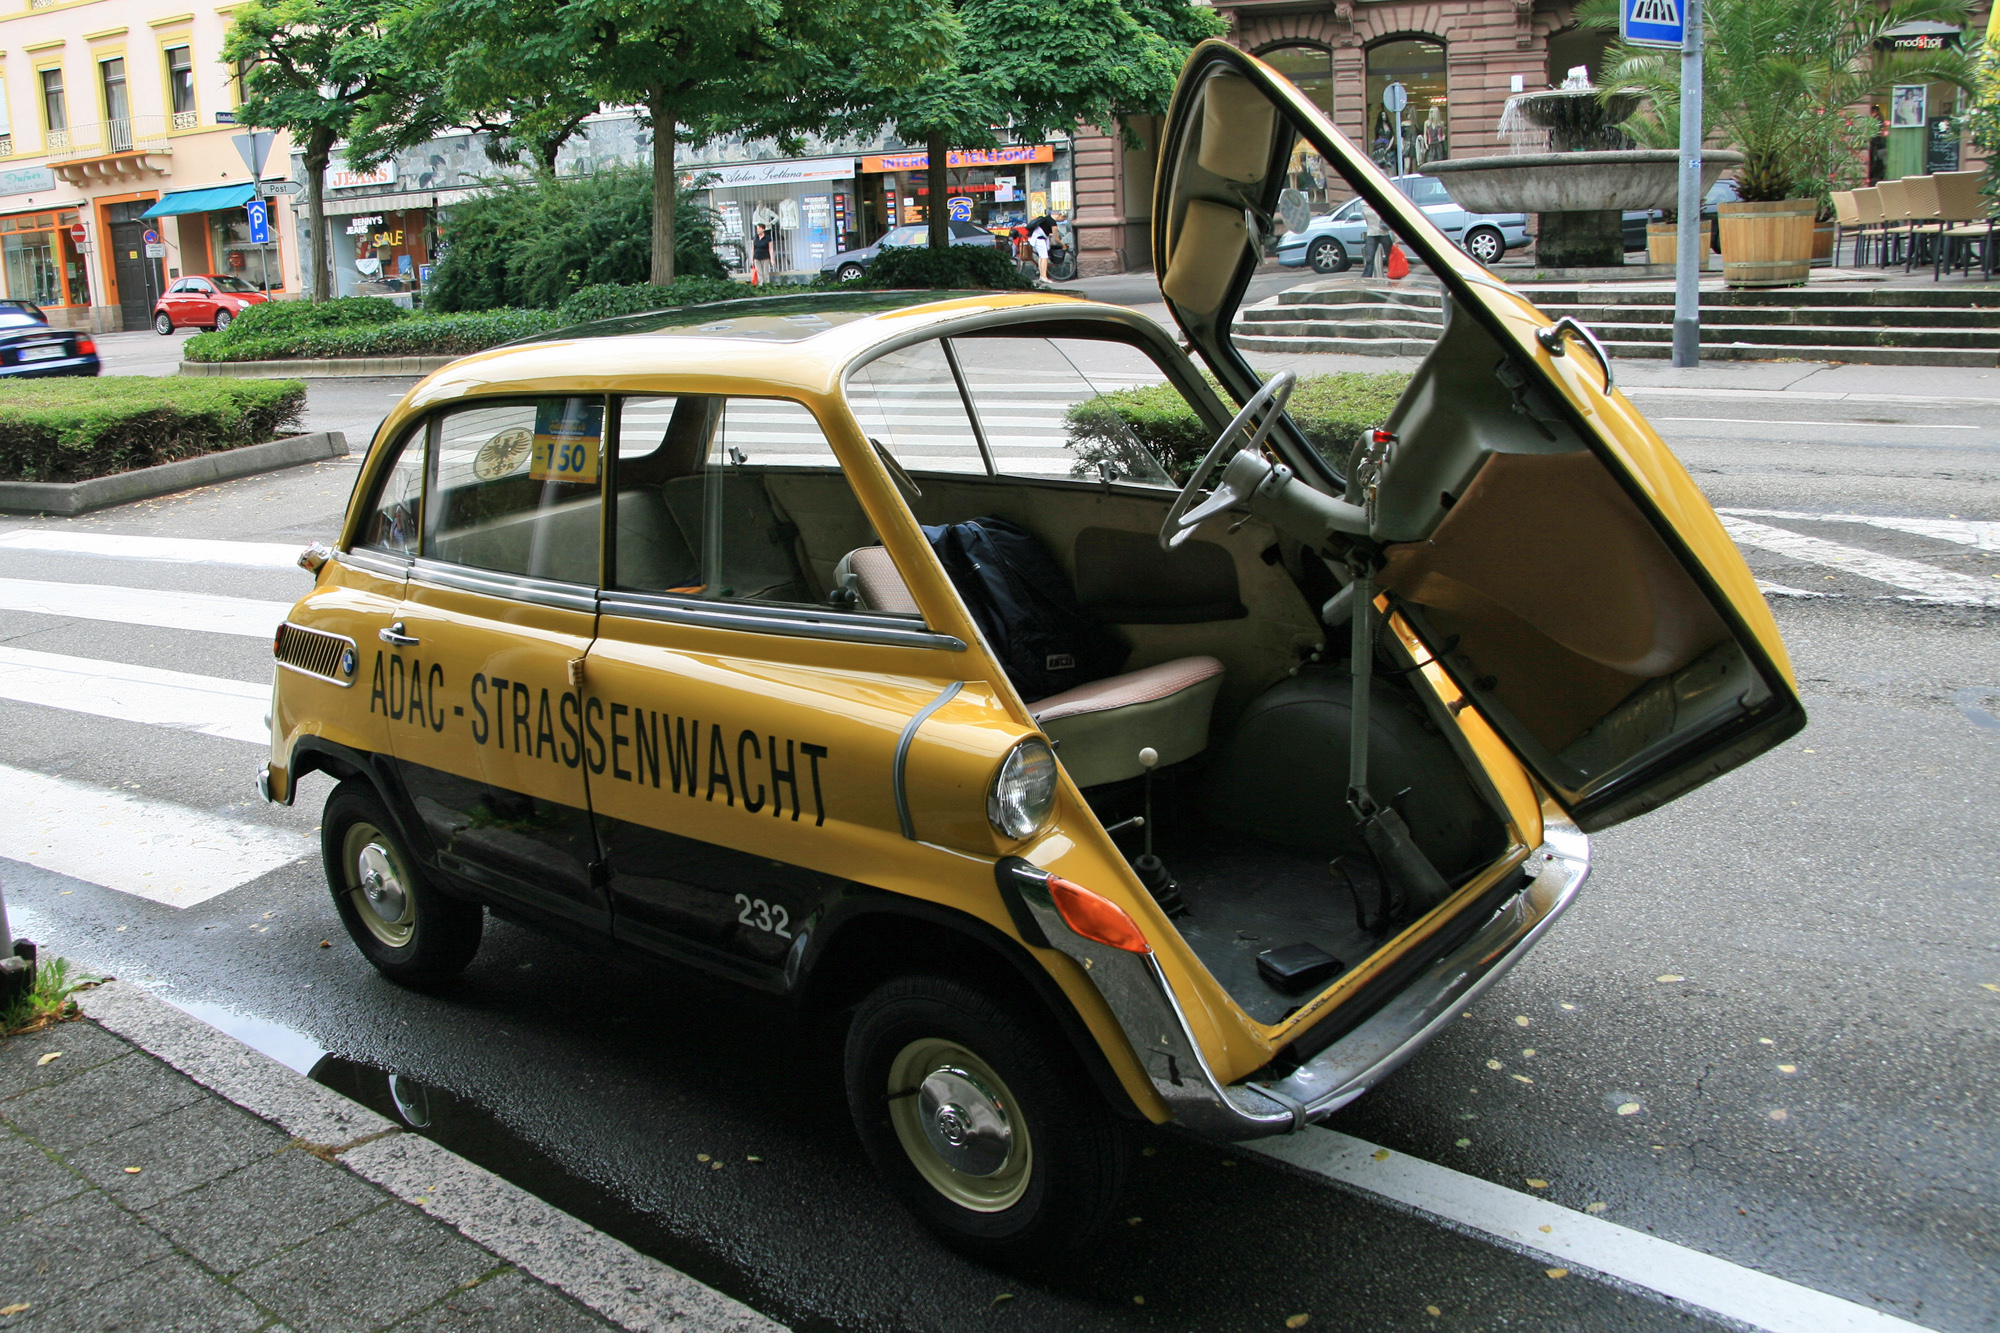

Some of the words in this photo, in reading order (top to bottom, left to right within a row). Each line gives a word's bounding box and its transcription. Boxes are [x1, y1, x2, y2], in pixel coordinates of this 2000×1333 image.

[881, 156, 929, 168] INTERN
[950, 154, 959, 164] &
[964, 149, 1036, 163] TELEFONIE
[333, 168, 388, 187] JEANS
[724, 170, 757, 183] Atelier
[759, 166, 802, 181] Svetlana
[269, 185, 287, 193] Post
[253, 212, 263, 229] P
[352, 216, 383, 226] BENNY'S
[345, 225, 368, 235] JEANS
[373, 230, 403, 247] SALE
[547, 444, 586, 473] 150
[735, 893, 791, 939] 232
